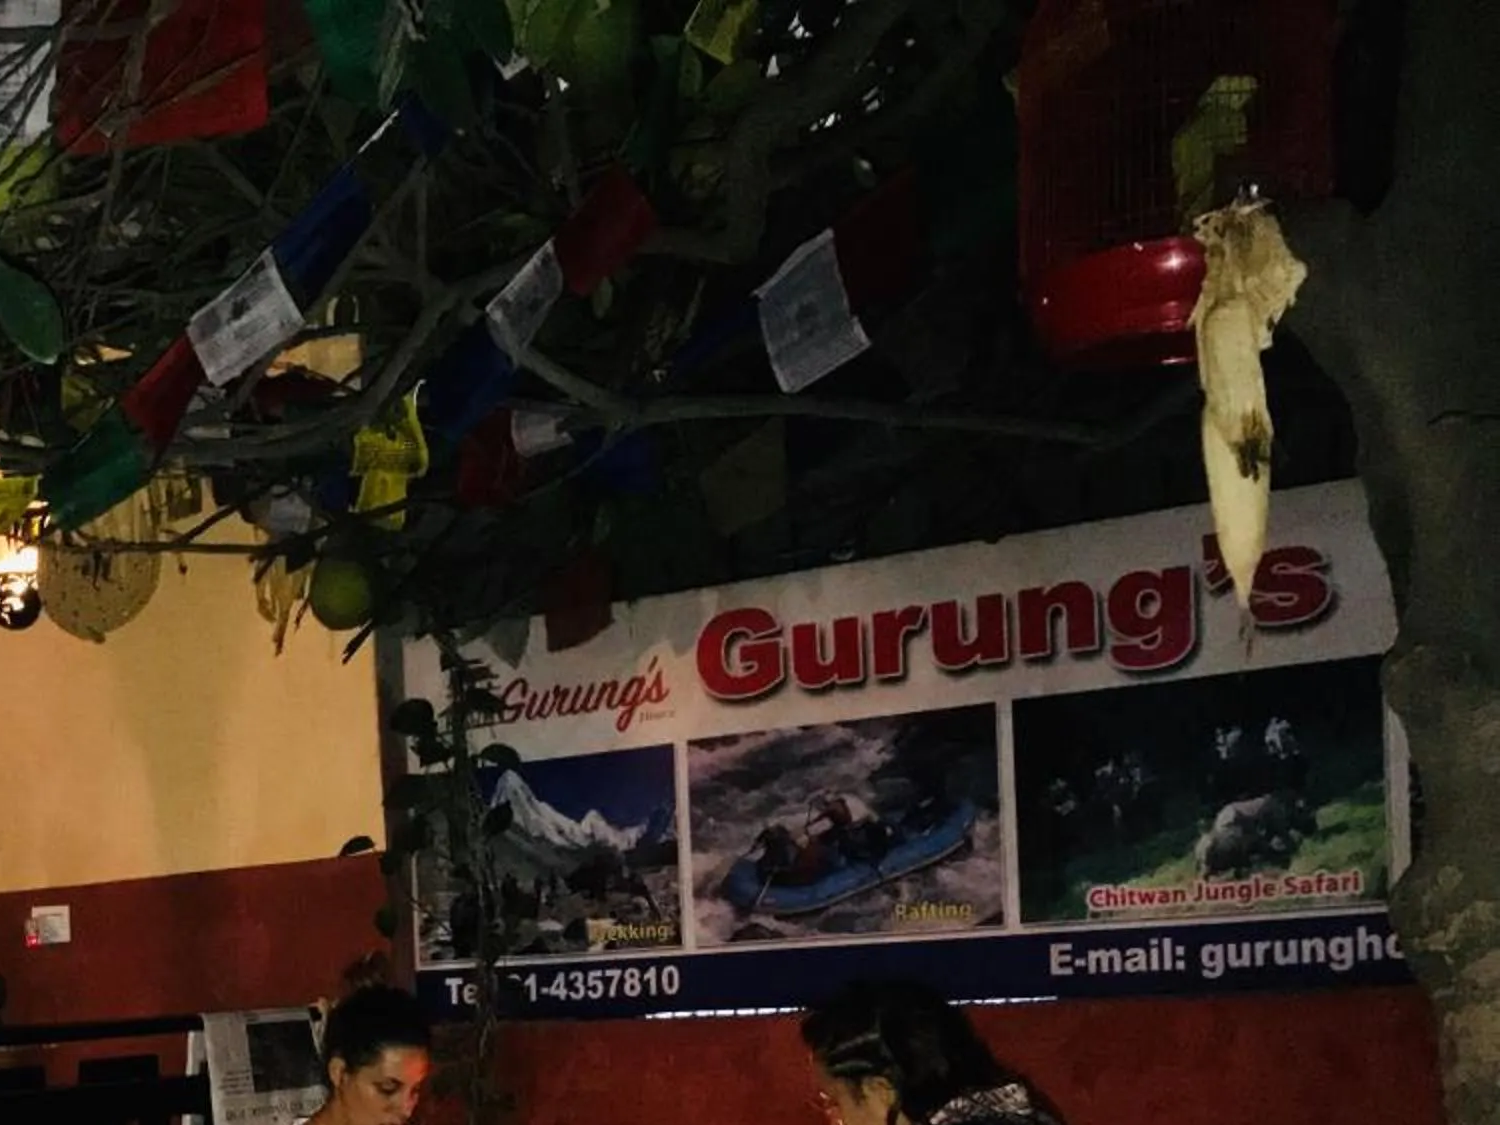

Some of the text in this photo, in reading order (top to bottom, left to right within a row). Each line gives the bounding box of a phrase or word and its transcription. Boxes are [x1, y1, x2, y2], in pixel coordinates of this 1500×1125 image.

[696, 533, 1333, 699] Gurung's
[496, 655, 670, 732] Gurung's
[1090, 871, 1361, 909] Chitwan Jungle Safari
[894, 901, 973, 921] Rafting
[1050, 937, 1186, 976] E-mail:
